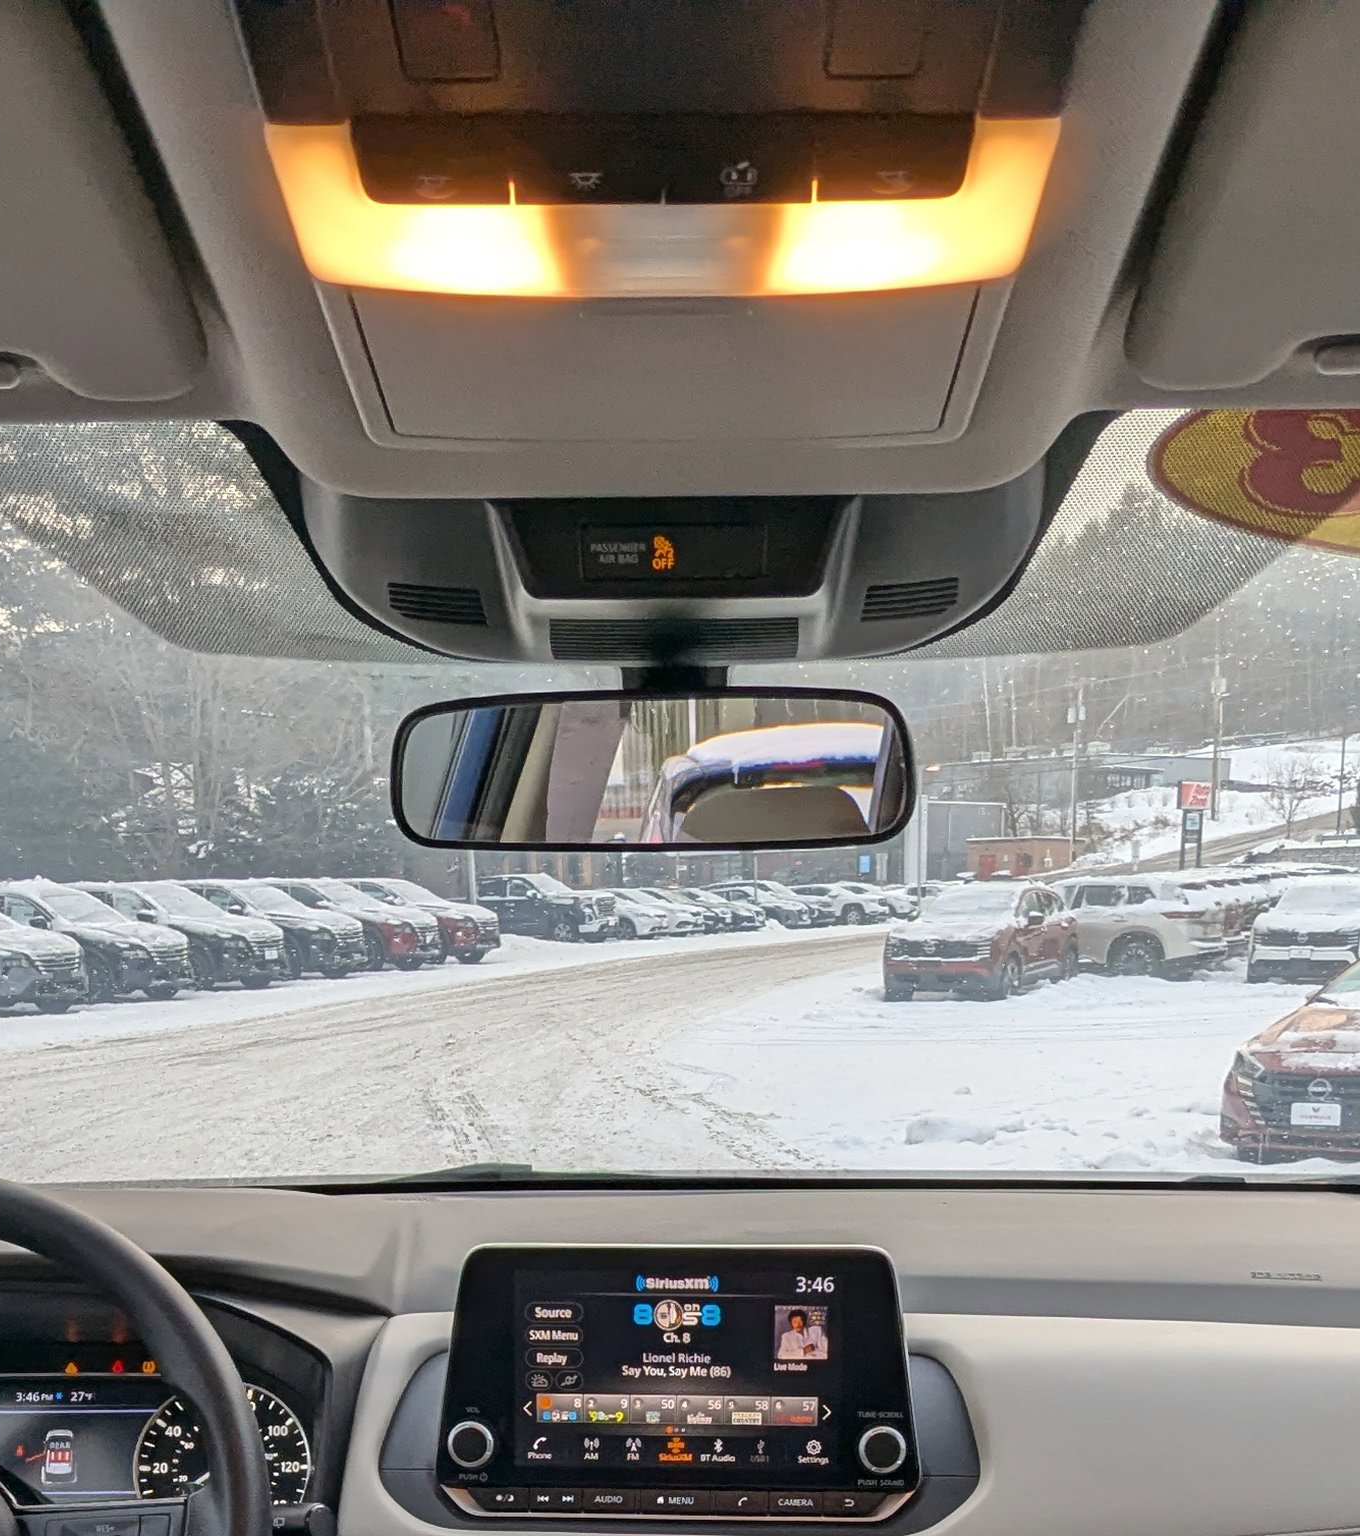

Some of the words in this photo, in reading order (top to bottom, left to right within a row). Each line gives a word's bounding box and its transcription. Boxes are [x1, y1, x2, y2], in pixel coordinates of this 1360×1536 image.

[651, 558, 675, 570] OFF
[795, 1276, 835, 1293] 3:46
[534, 1306, 573, 1319] Source
[528, 1329, 551, 1341] SXM
[551, 1329, 579, 1341] Menu
[663, 1333, 681, 1344] Ch.
[682, 1332, 691, 1344] 8
[536, 1352, 568, 1366] Replay
[642, 1352, 676, 1363] Lionel
[678, 1352, 712, 1364] Richie
[621, 1365, 641, 1378] Say
[643, 1366, 667, 1378] You,
[668, 1366, 688, 1378] Say
[690, 1366, 708, 1377] Me
[709, 1366, 732, 1379] (86)
[15, 1391, 40, 1402] 3:46
[40, 1393, 54, 1401] PM
[573, 1398, 582, 1408] 8
[620, 1398, 628, 1409] 9
[660, 1399, 676, 1410] 50
[707, 1399, 722, 1410] 56
[754, 1400, 769, 1411] 58
[802, 1401, 816, 1412] 57
[164, 1425, 182, 1438] 40
[267, 1425, 289, 1437] 100
[527, 1451, 553, 1460] Phone
[583, 1453, 599, 1461] AM
[626, 1453, 640, 1461] FM
[658, 1453, 693, 1462] SiriusXM
[700, 1454, 711, 1462] BT
[711, 1454, 736, 1463] Audio
[797, 1455, 829, 1465] Settings
[152, 1462, 169, 1475] 20
[280, 1461, 301, 1474] 120
[594, 1495, 623, 1503] AUDIO
[668, 1496, 694, 1505] MENU
[778, 1498, 813, 1507] CAMERA
